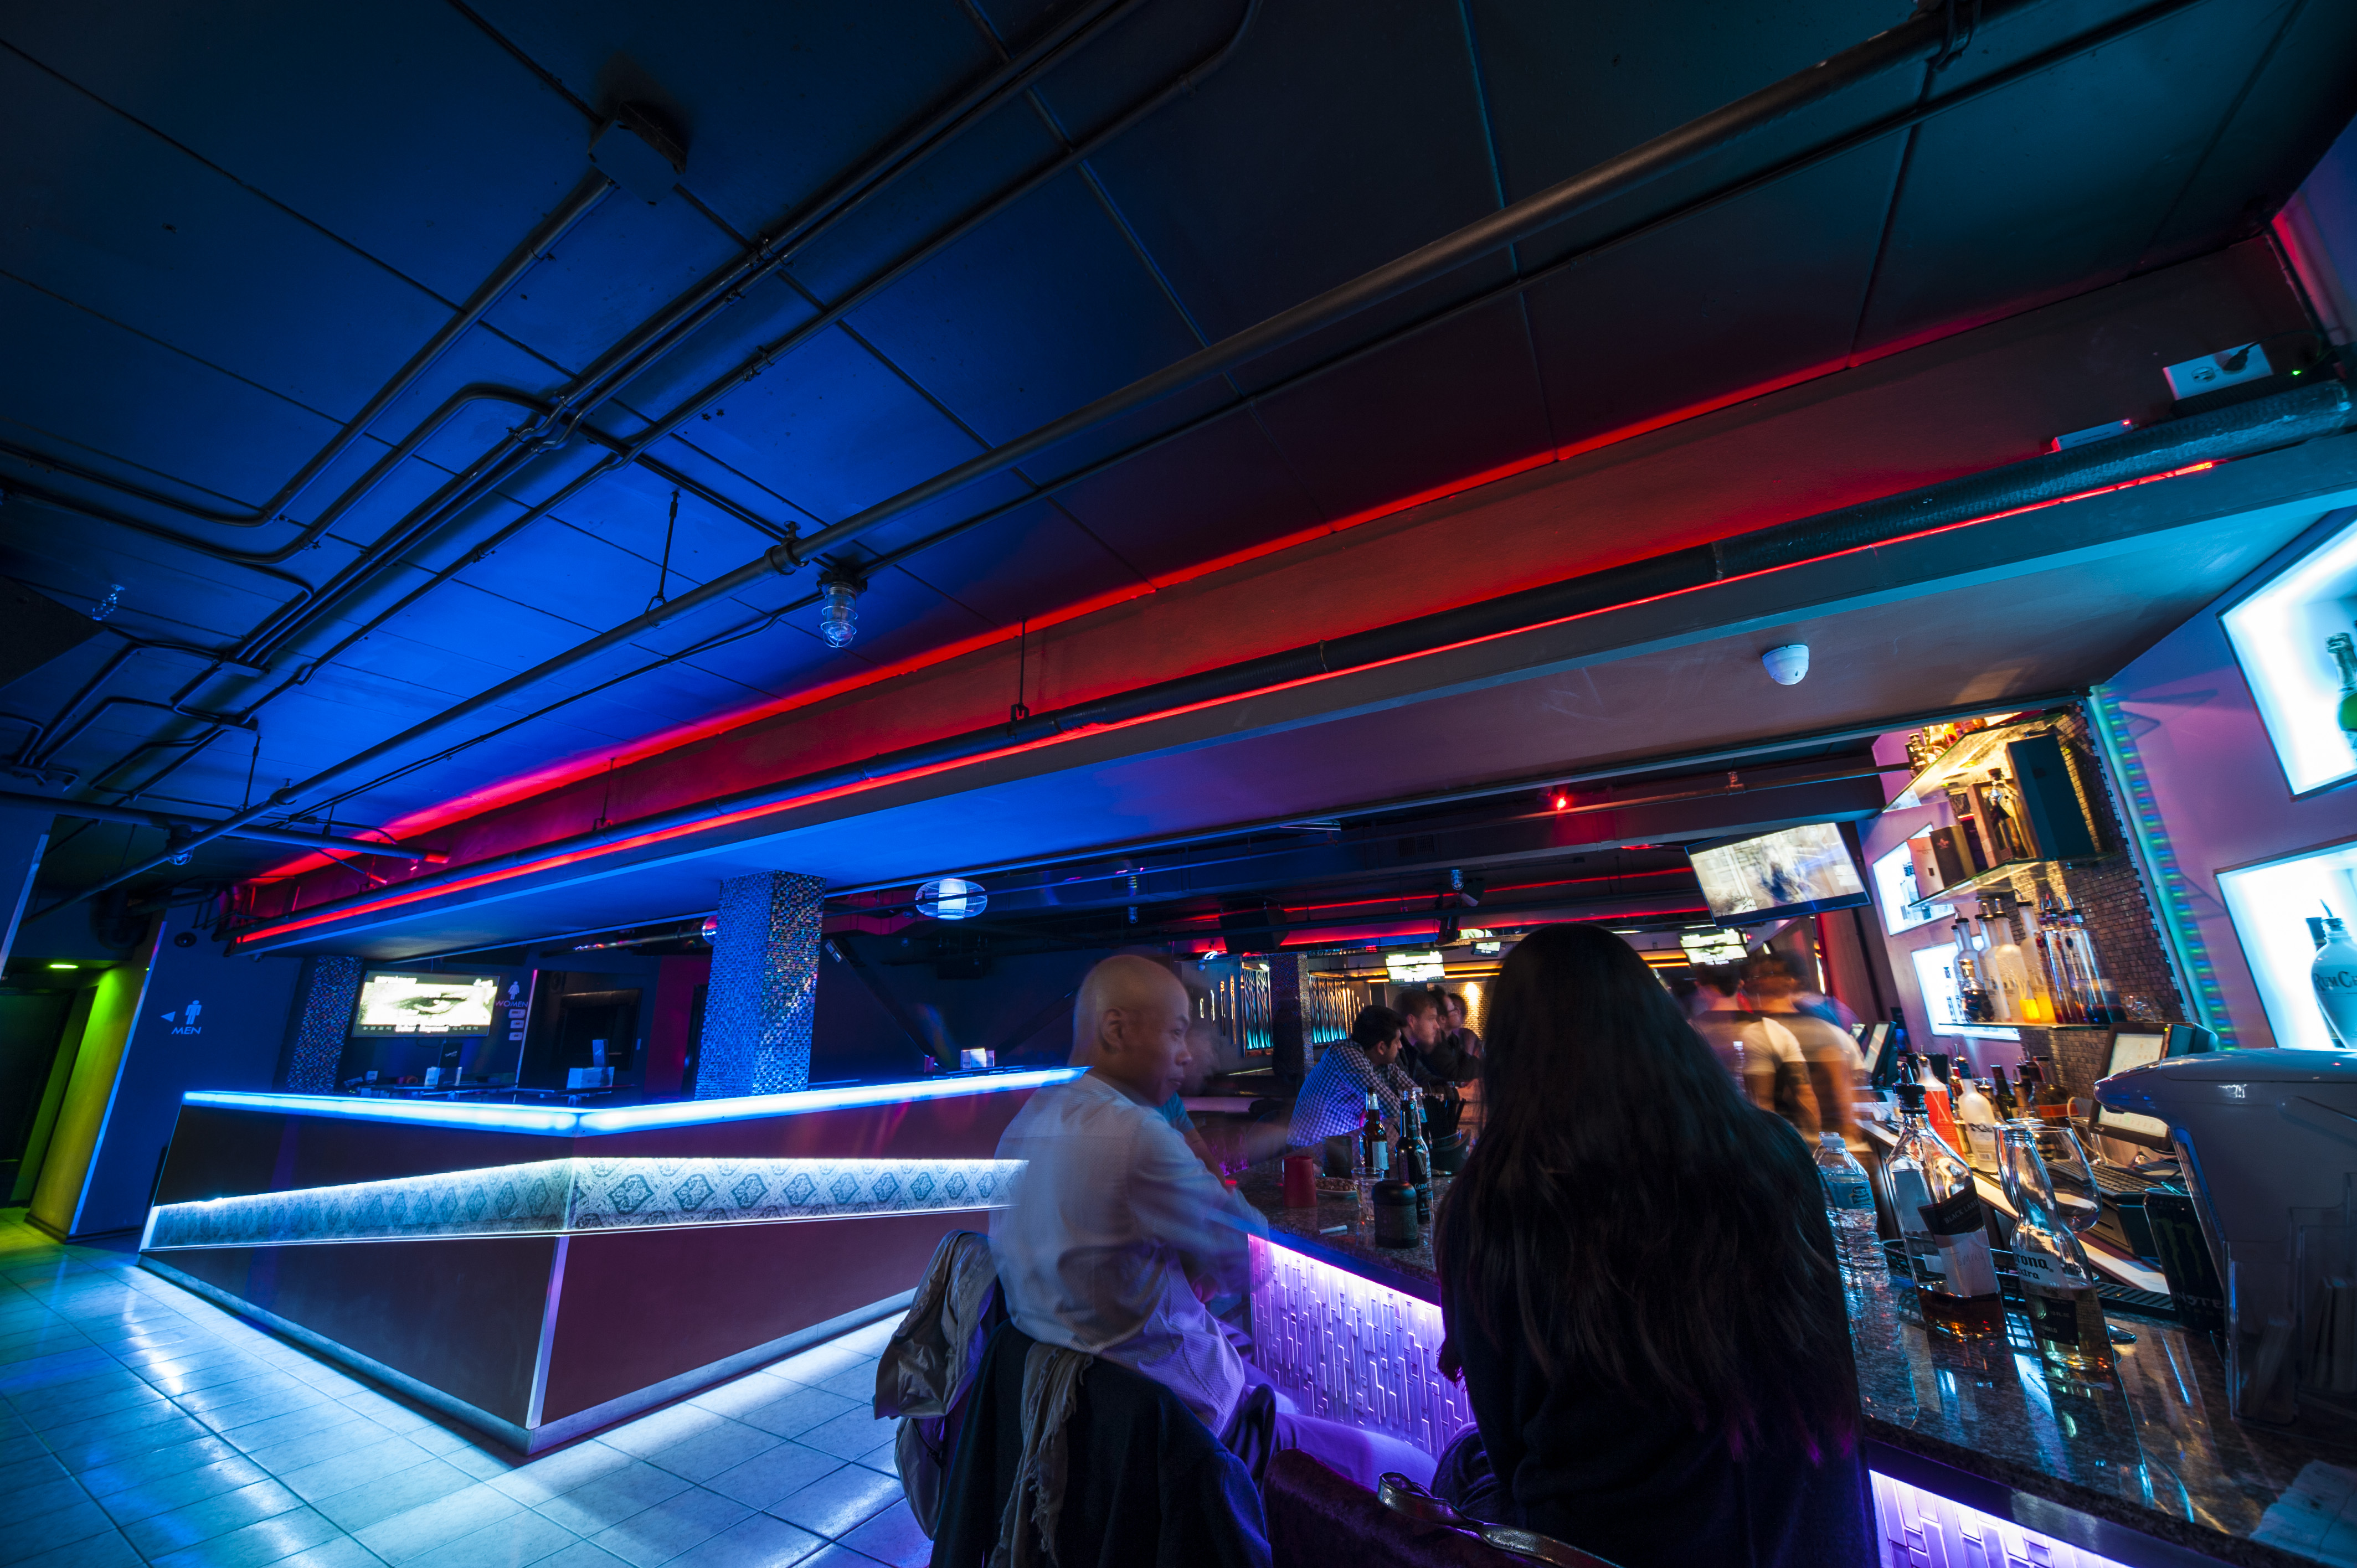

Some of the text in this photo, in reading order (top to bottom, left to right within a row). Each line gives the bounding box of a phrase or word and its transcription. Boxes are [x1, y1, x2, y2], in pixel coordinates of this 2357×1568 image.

[495, 999, 529, 1008] WOMEN
[171, 1026, 202, 1035] MEN
[1943, 1209, 1964, 1224] BLACK
[2014, 1253, 2050, 1270] rona
[2018, 1266, 2040, 1280] xtra
[2173, 1291, 2225, 1309] NSTE
